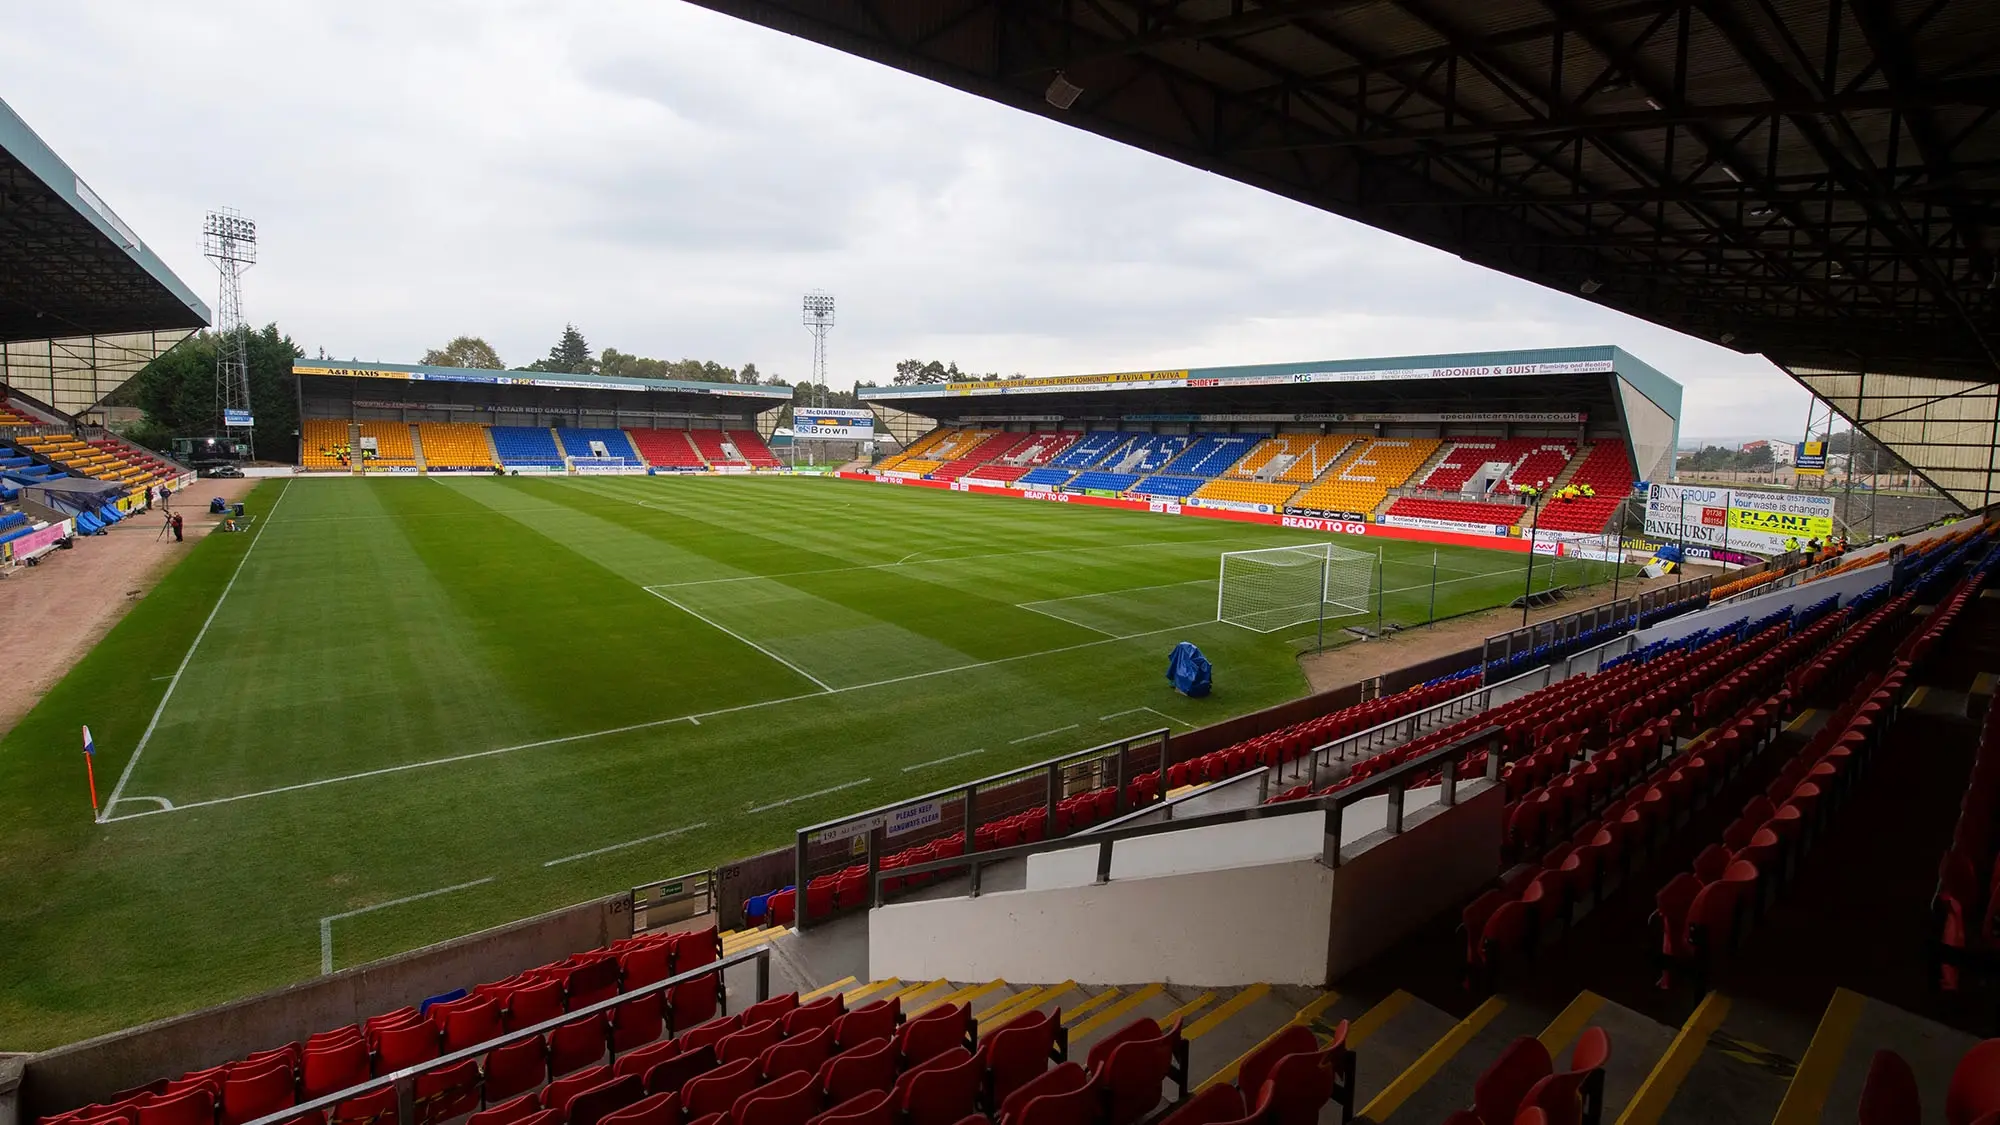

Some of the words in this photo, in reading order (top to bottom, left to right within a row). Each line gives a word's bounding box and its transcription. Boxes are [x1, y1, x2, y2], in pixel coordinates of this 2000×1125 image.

[352, 369, 380, 377] TAXIS
[1432, 368, 1489, 377] McDONALD
[1493, 367, 1502, 375] &
[1506, 365, 1537, 374] BUIST
[1075, 375, 1110, 384] COMMUNITY
[1440, 412, 1577, 421] specialistcarsnissan.co.uk
[811, 426, 848, 435] Brown
[875, 475, 889, 484] READY
[1024, 490, 1046, 500] READY
[1047, 493, 1057, 501] TO
[1058, 494, 1069, 502] GO
[1681, 489, 1717, 502] GROUP
[1735, 491, 1785, 502] binngroup.co.uk
[1787, 495, 1804, 503] 01577
[1734, 499, 1751, 508] Your
[1753, 502, 1778, 511] waste
[1788, 504, 1830, 518] changing
[1419, 518, 1440, 526] Premier
[1440, 520, 1468, 528] Insurance
[1665, 513, 1697, 523] CONTACTS
[1740, 511, 1811, 526] PLANT
[1282, 517, 1324, 530] READY
[1325, 521, 1343, 532] TO
[1346, 524, 1366, 535] GO
[1645, 519, 1716, 541] PANKHURST
[1740, 520, 1811, 533] GLAZING
[1620, 541, 1711, 558] william.com
[895, 807, 917, 820] PLEASE
[918, 804, 933, 815] KEEP
[823, 830, 837, 841] 193
[871, 818, 881, 827] 93
[888, 819, 920, 834] GANGWAYS
[921, 813, 939, 825] CLEAR
[609, 897, 631, 914] 129
